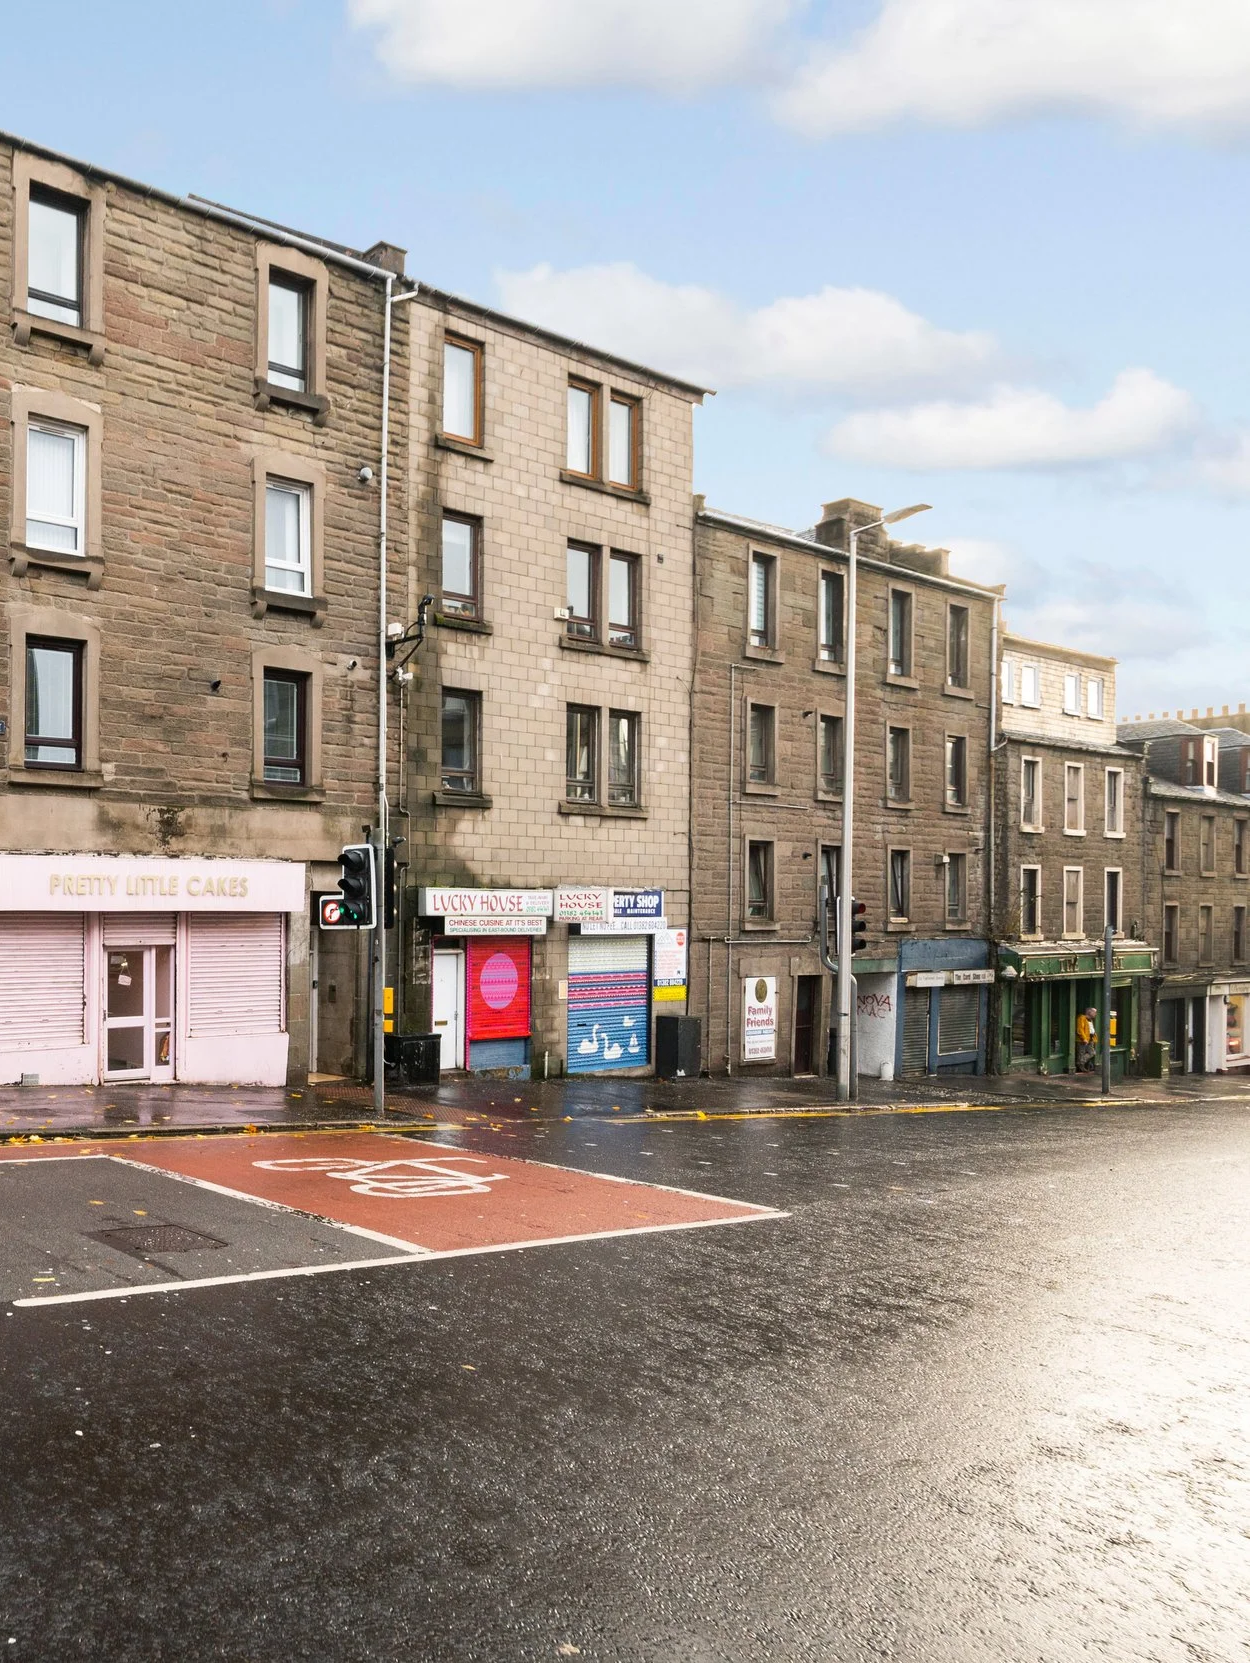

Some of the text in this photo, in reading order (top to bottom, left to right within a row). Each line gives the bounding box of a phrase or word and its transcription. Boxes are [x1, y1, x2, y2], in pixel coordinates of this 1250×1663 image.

[49, 874, 249, 897] PRETTY LITTLE CAKES
[433, 894, 523, 912] LUCKY HOUSE
[636, 895, 659, 908] SHOP
[621, 921, 632, 930] CALL
[857, 993, 892, 1008] NOVA
[748, 1005, 772, 1016] Family
[857, 1004, 887, 1018] MAC
[746, 1017, 774, 1028] Friends
